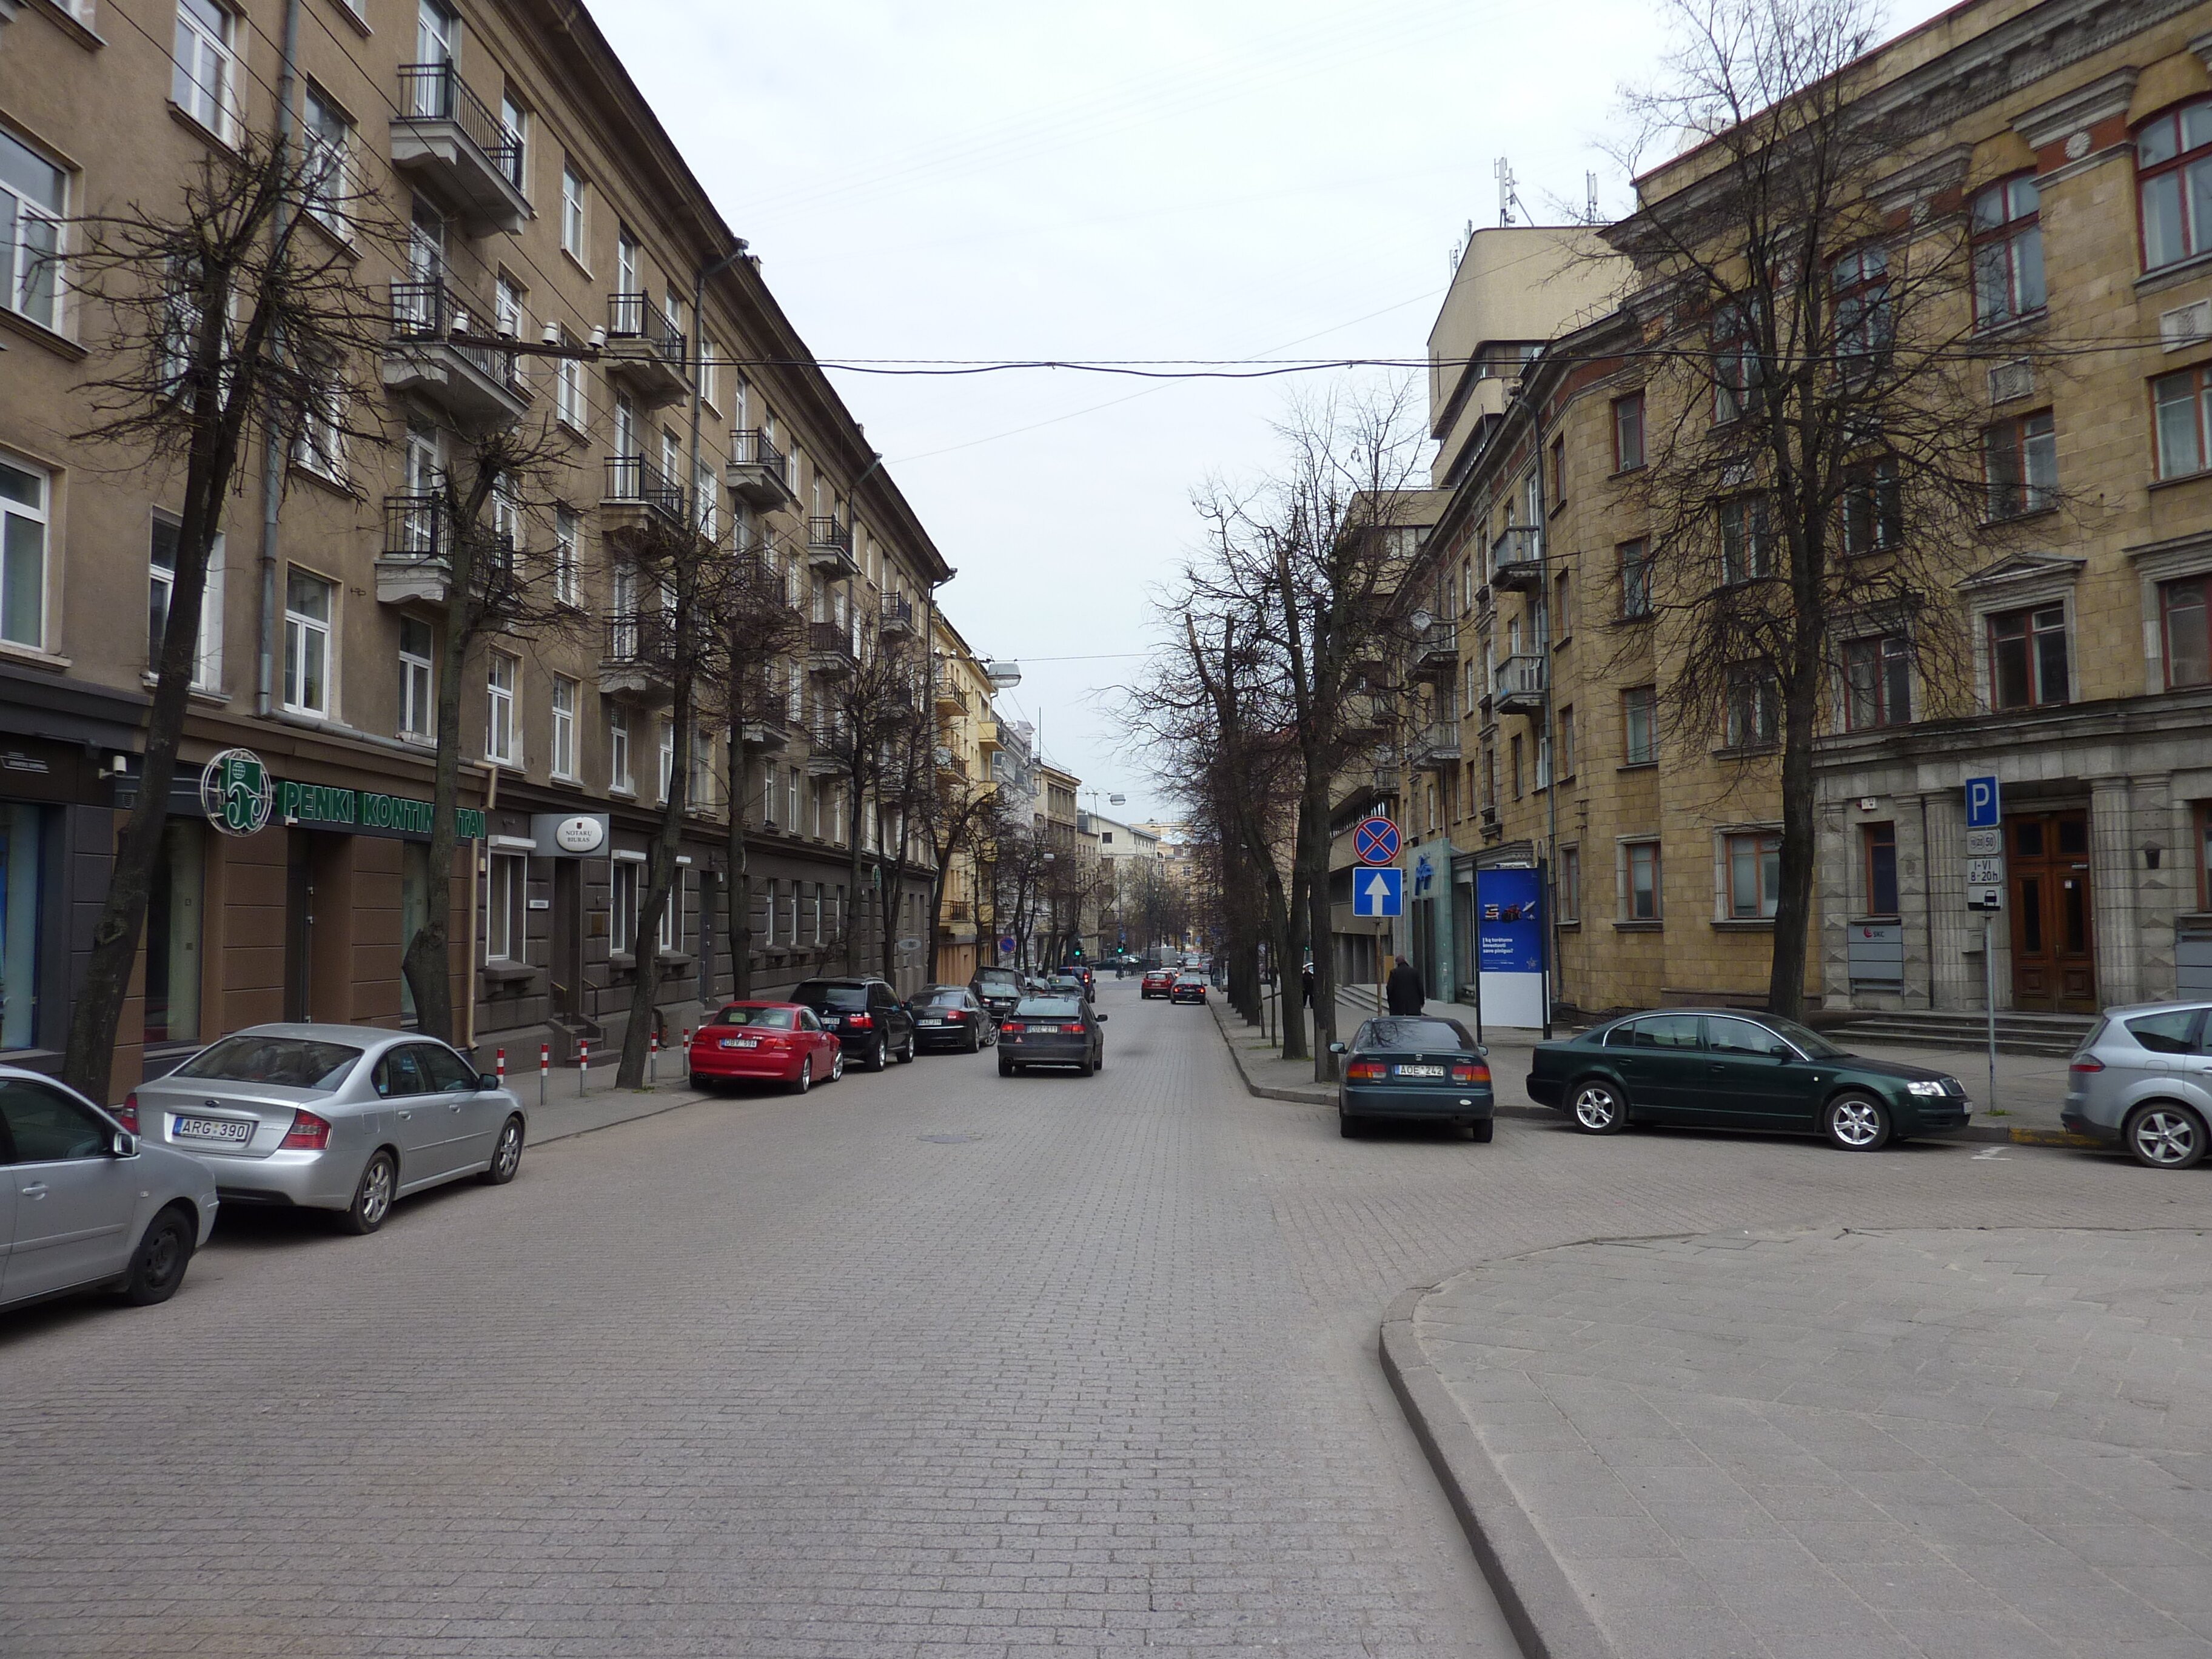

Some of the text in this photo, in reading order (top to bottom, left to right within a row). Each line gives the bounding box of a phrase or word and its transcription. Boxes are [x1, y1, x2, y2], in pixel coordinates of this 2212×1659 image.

[284, 781, 485, 840] PENKI KONTINTAI
[1972, 783, 1989, 821] P
[1985, 837, 1993, 847] 50
[1974, 860, 1991, 871] I-VI
[183, 1120, 211, 1134] ARG
[220, 1124, 245, 1138] 390
